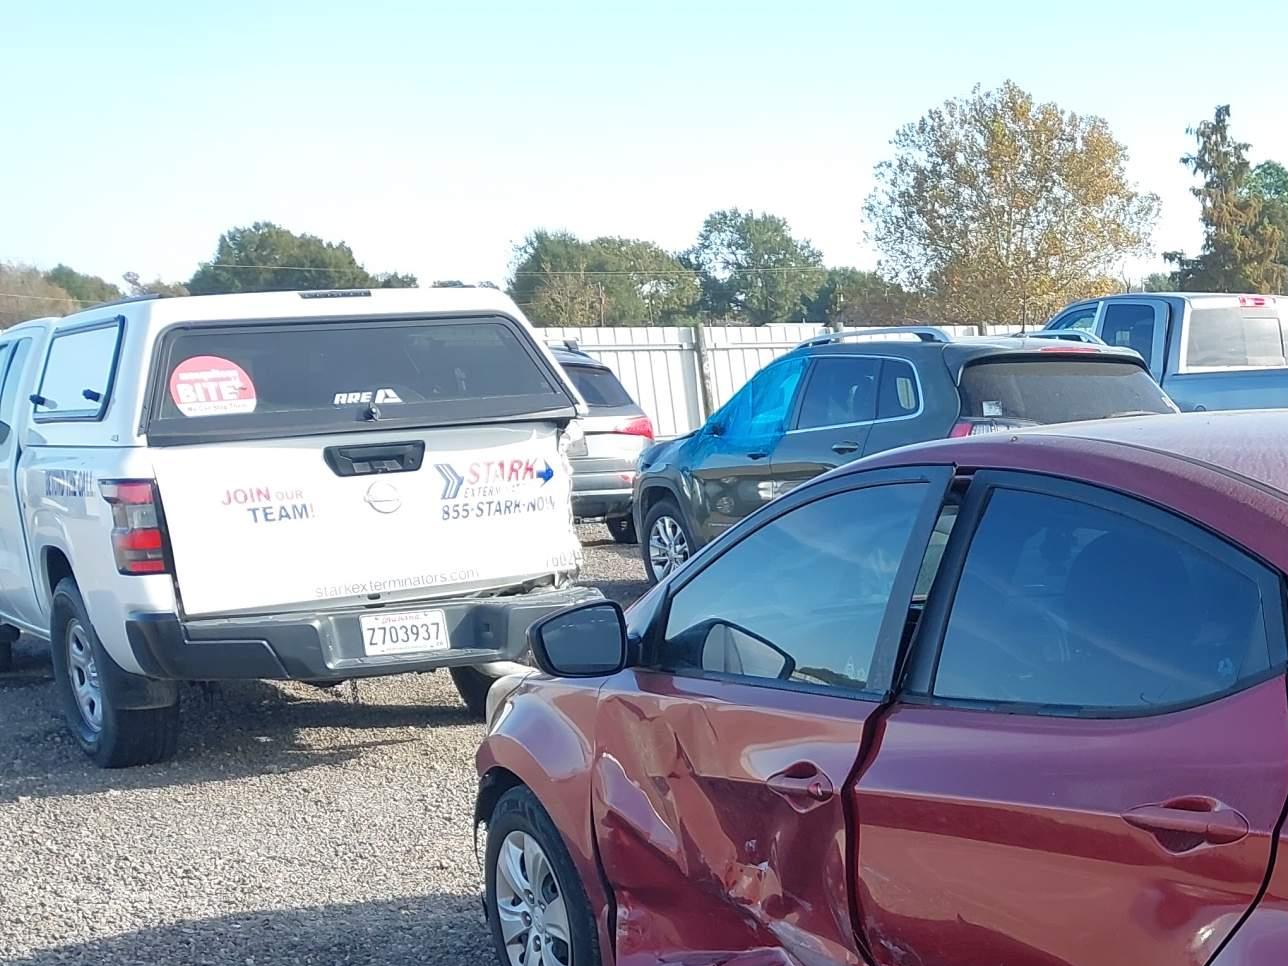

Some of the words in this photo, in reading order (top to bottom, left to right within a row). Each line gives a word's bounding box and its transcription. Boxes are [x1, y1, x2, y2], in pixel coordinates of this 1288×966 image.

[175, 381, 240, 403] BITE
[333, 391, 373, 405] ARE
[466, 457, 537, 485] STARK
[221, 486, 271, 506] JOIN
[275, 489, 304, 501] OUR
[247, 502, 317, 523] TEAM!
[314, 568, 480, 598] starkexterminators.com
[366, 622, 440, 646] Z703937
